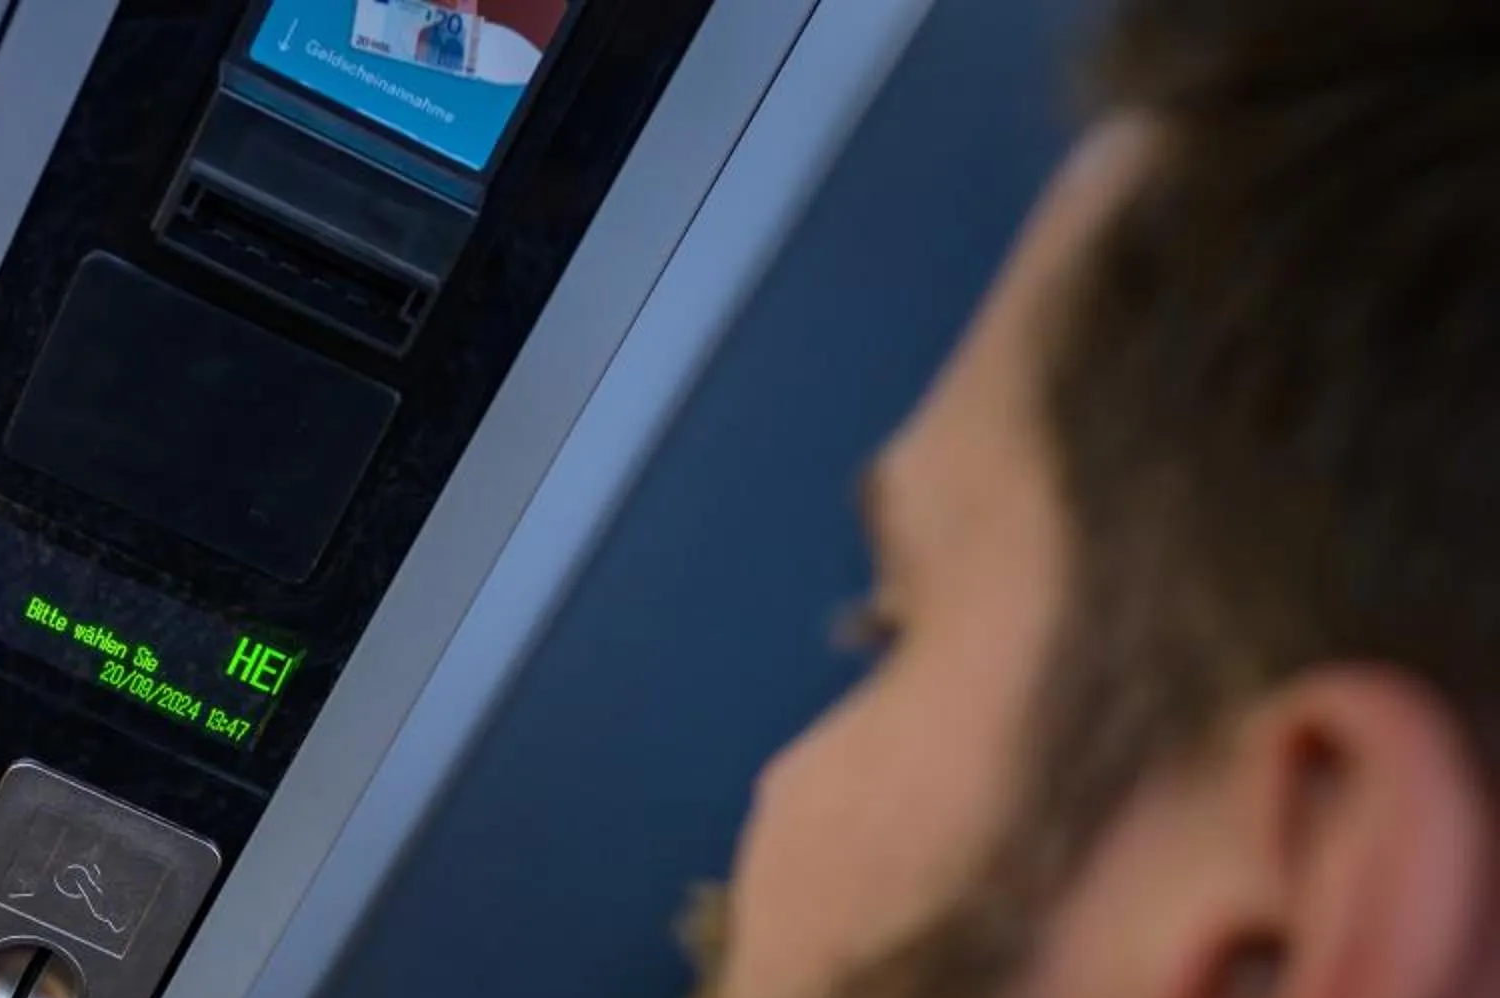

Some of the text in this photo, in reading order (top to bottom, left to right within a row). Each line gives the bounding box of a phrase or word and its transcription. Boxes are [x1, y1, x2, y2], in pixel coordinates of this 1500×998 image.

[305, 38, 456, 125] Geldscheinannahme
[26, 597, 159, 673] Bitte wählen Sie
[205, 707, 251, 742] 13:47
